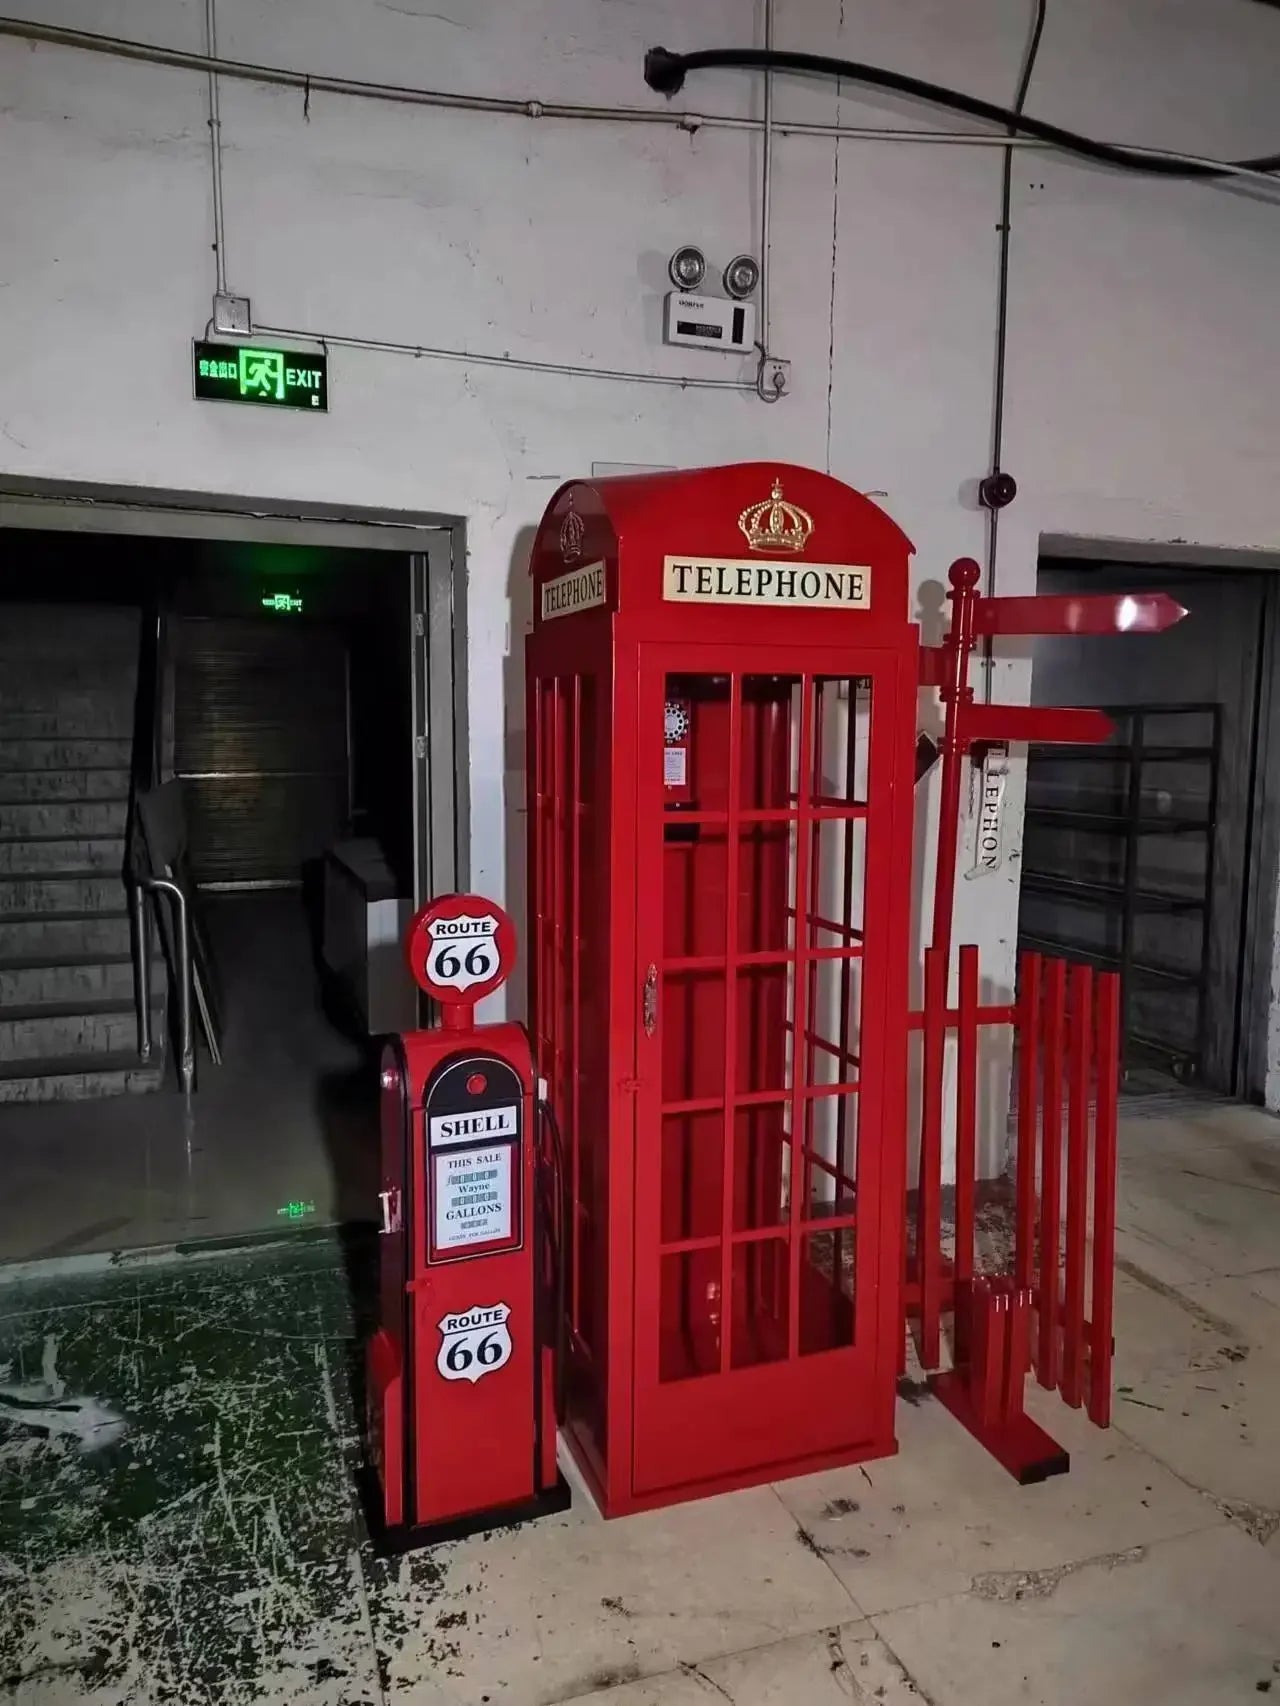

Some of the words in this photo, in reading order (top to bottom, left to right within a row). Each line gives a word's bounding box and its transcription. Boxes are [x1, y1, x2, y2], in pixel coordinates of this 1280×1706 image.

[286, 368, 322, 388] EXIT
[545, 568, 602, 613] TELEPHONE
[672, 564, 864, 601] TELEPHONE
[436, 921, 491, 935] ROUTE
[435, 943, 491, 978] 66
[441, 1114, 510, 1138] SHELL
[448, 1158, 472, 1169] THIS
[476, 1153, 502, 1164] SALE
[458, 1183, 490, 1193] Wayne
[446, 1203, 502, 1221] GALLONS
[447, 1309, 503, 1330] ROUTE
[446, 1331, 503, 1371] 66
